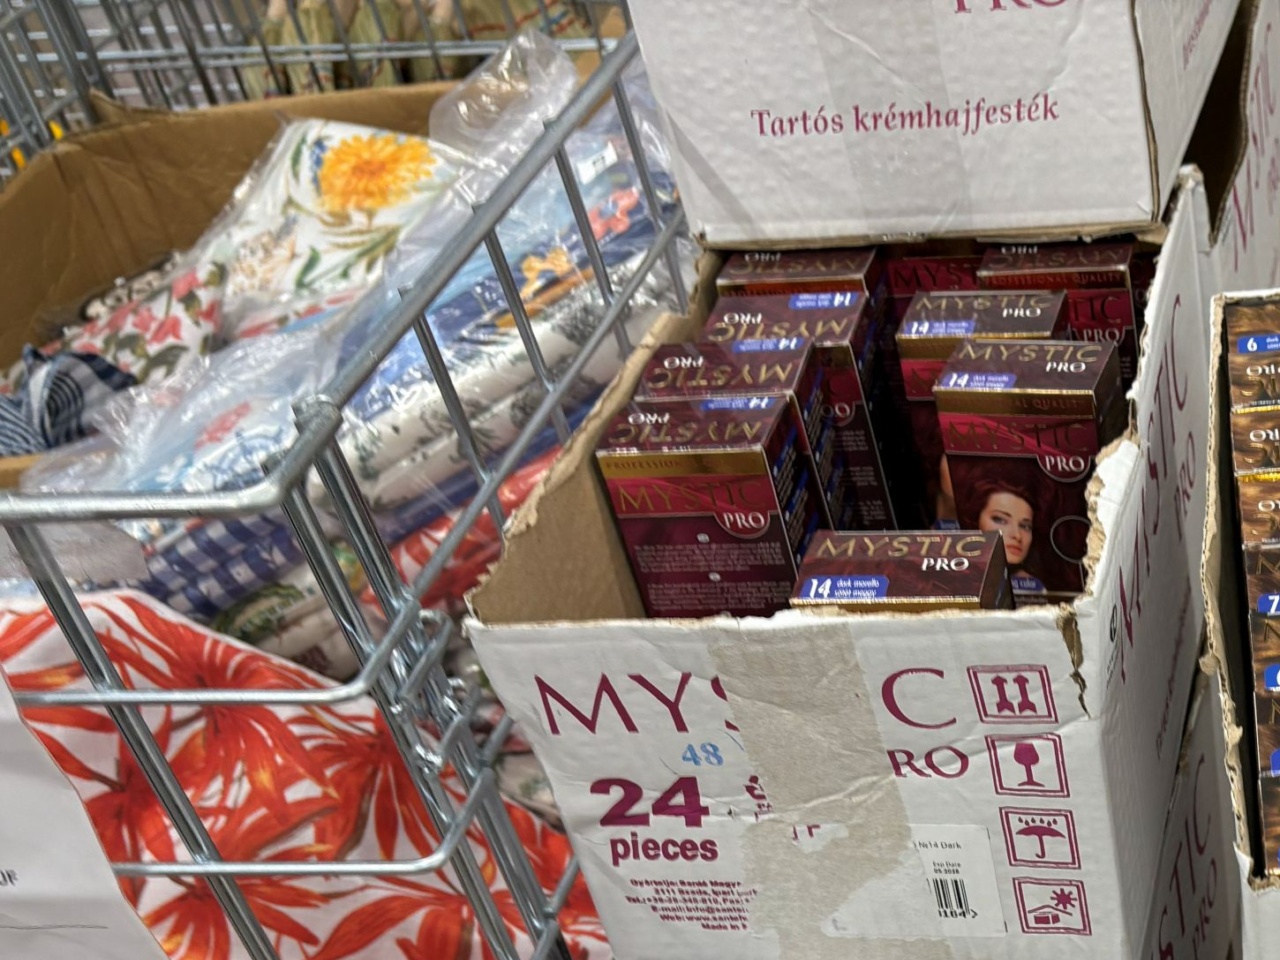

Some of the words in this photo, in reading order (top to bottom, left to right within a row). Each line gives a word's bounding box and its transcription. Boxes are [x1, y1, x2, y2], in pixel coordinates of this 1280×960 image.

[750, 107, 844, 138] Tartós
[853, 93, 1061, 136] krémhajfesték
[958, 344, 1102, 362] MYSTIC
[1045, 361, 1086, 374] PRO
[1044, 455, 1085, 473] PRO
[722, 511, 765, 529] PRO
[816, 535, 987, 558] MYSTIC
[921, 557, 970, 572] PRO
[681, 742, 725, 767] 48
[589, 775, 711, 828] 24
[609, 831, 719, 868] pieces
